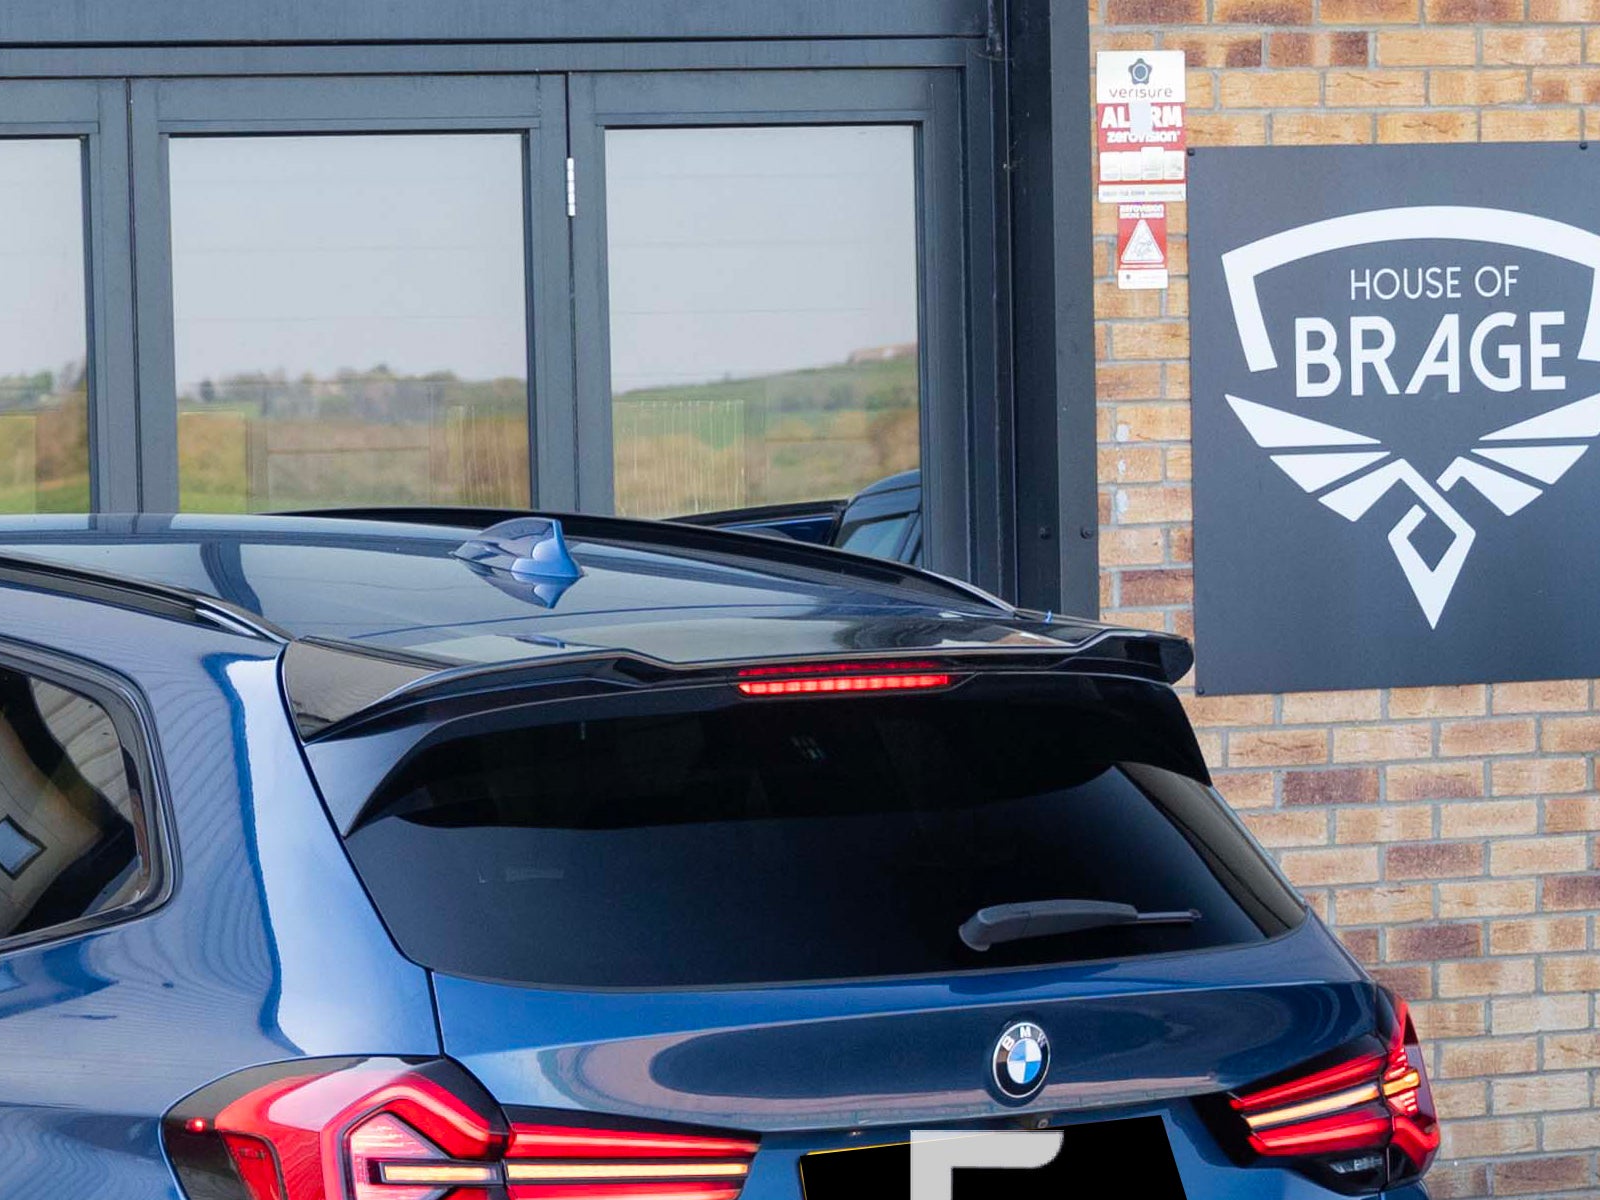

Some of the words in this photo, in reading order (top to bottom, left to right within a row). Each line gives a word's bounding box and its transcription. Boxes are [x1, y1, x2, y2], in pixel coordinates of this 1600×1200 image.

[1108, 87, 1173, 98] verisure
[1101, 105, 1183, 128] ALRM
[1350, 266, 1462, 301] HOUSE
[1474, 264, 1520, 297] OF
[1294, 310, 1566, 398] BRAGE
[1001, 1026, 1048, 1051] BMW
